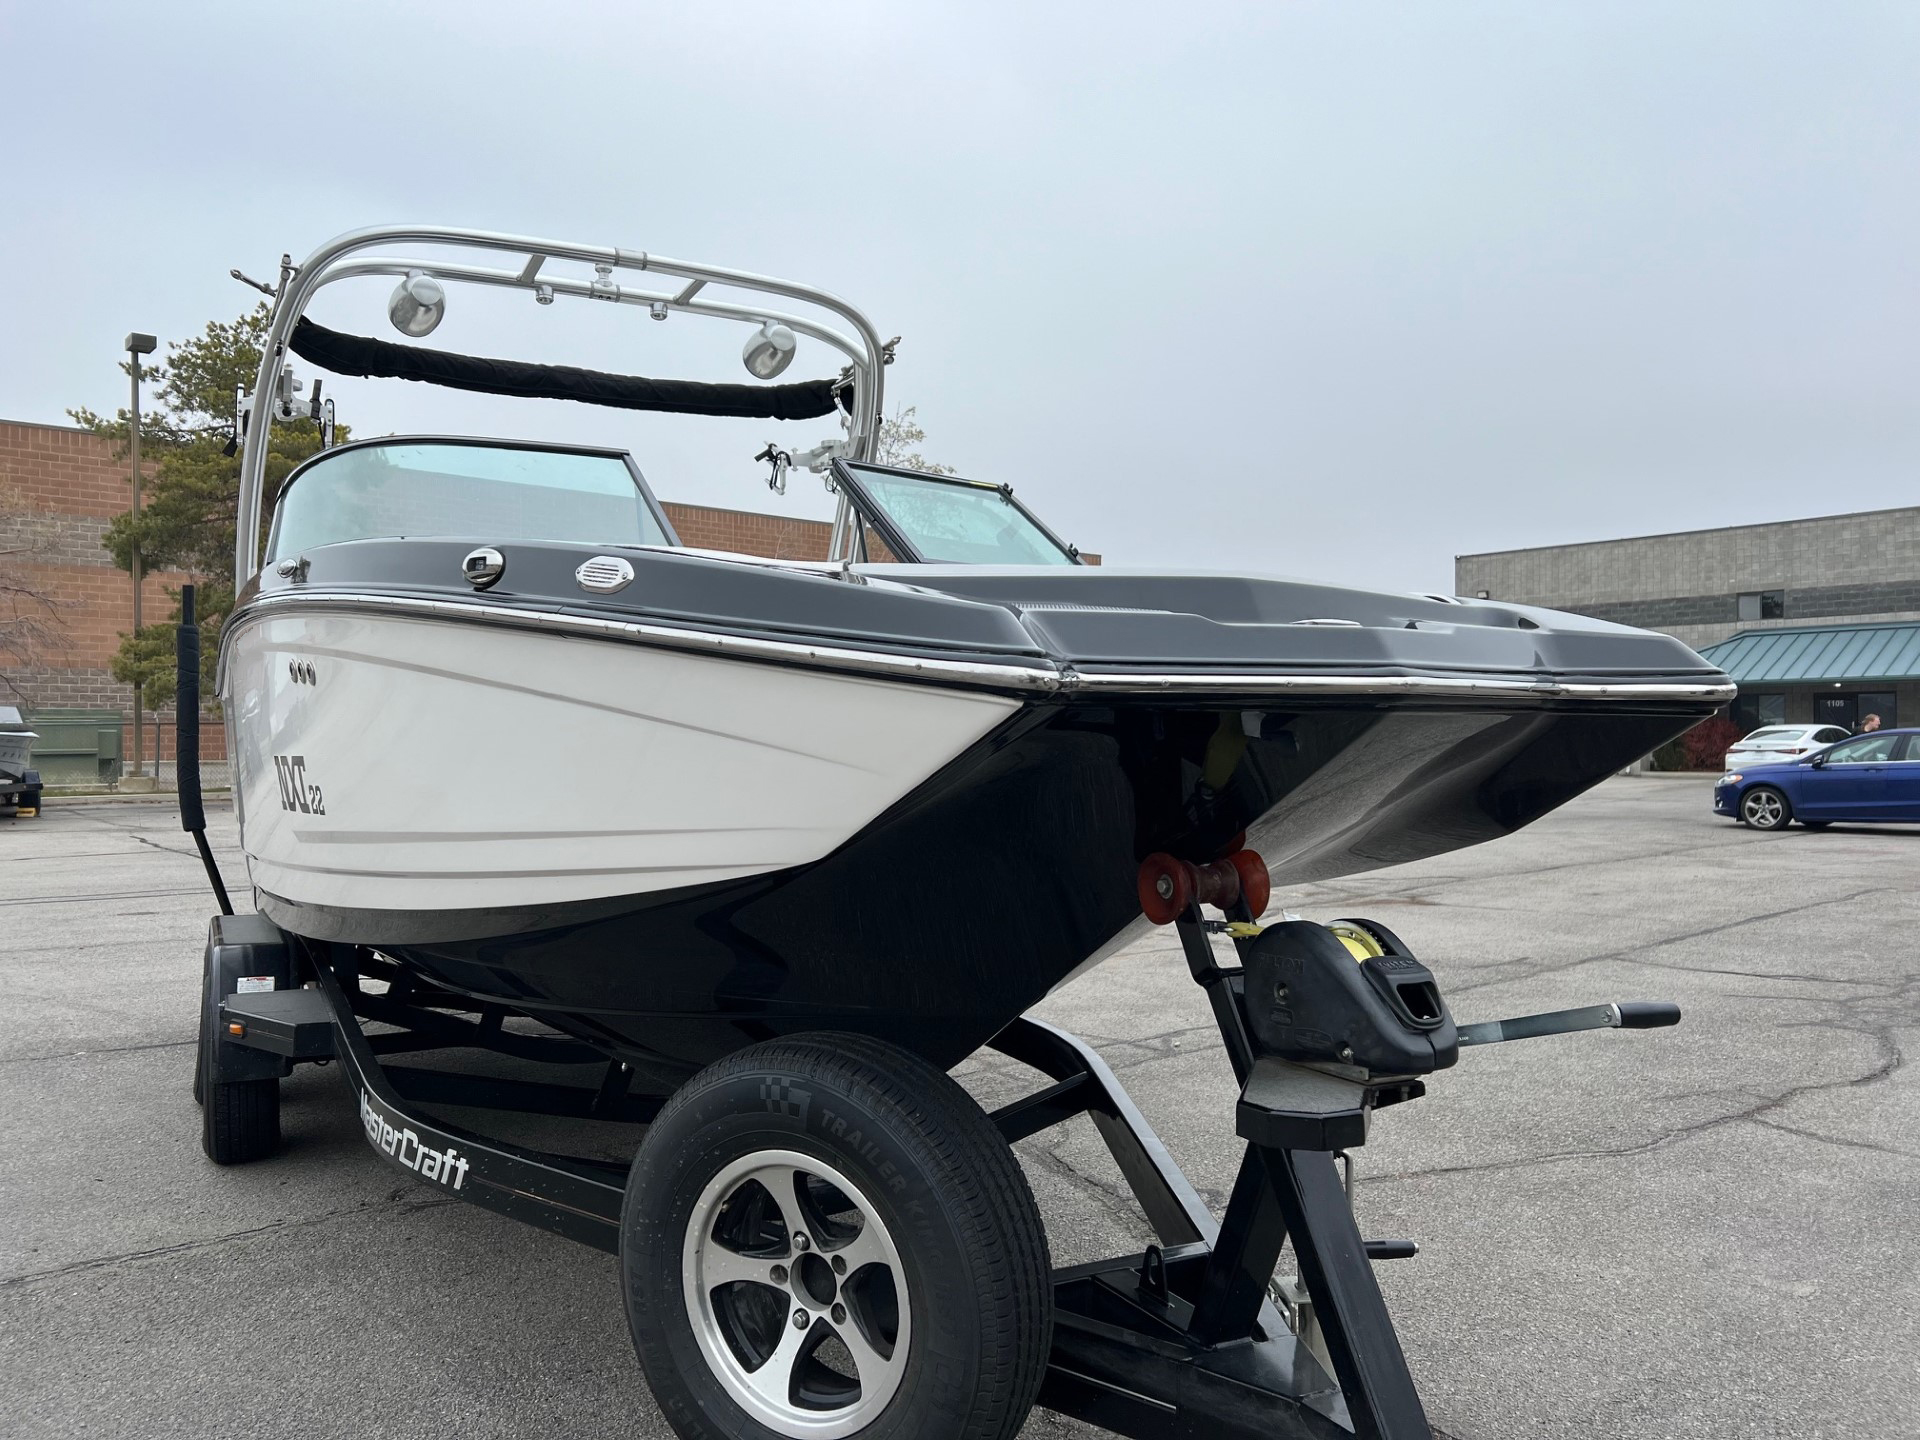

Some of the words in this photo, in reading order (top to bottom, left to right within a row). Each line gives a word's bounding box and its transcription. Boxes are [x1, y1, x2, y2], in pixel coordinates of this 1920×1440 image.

[273, 755, 311, 814] NXT
[308, 784, 326, 816] 22
[360, 1086, 470, 1190] MasterCraft
[820, 1107, 909, 1195] TRAILER
